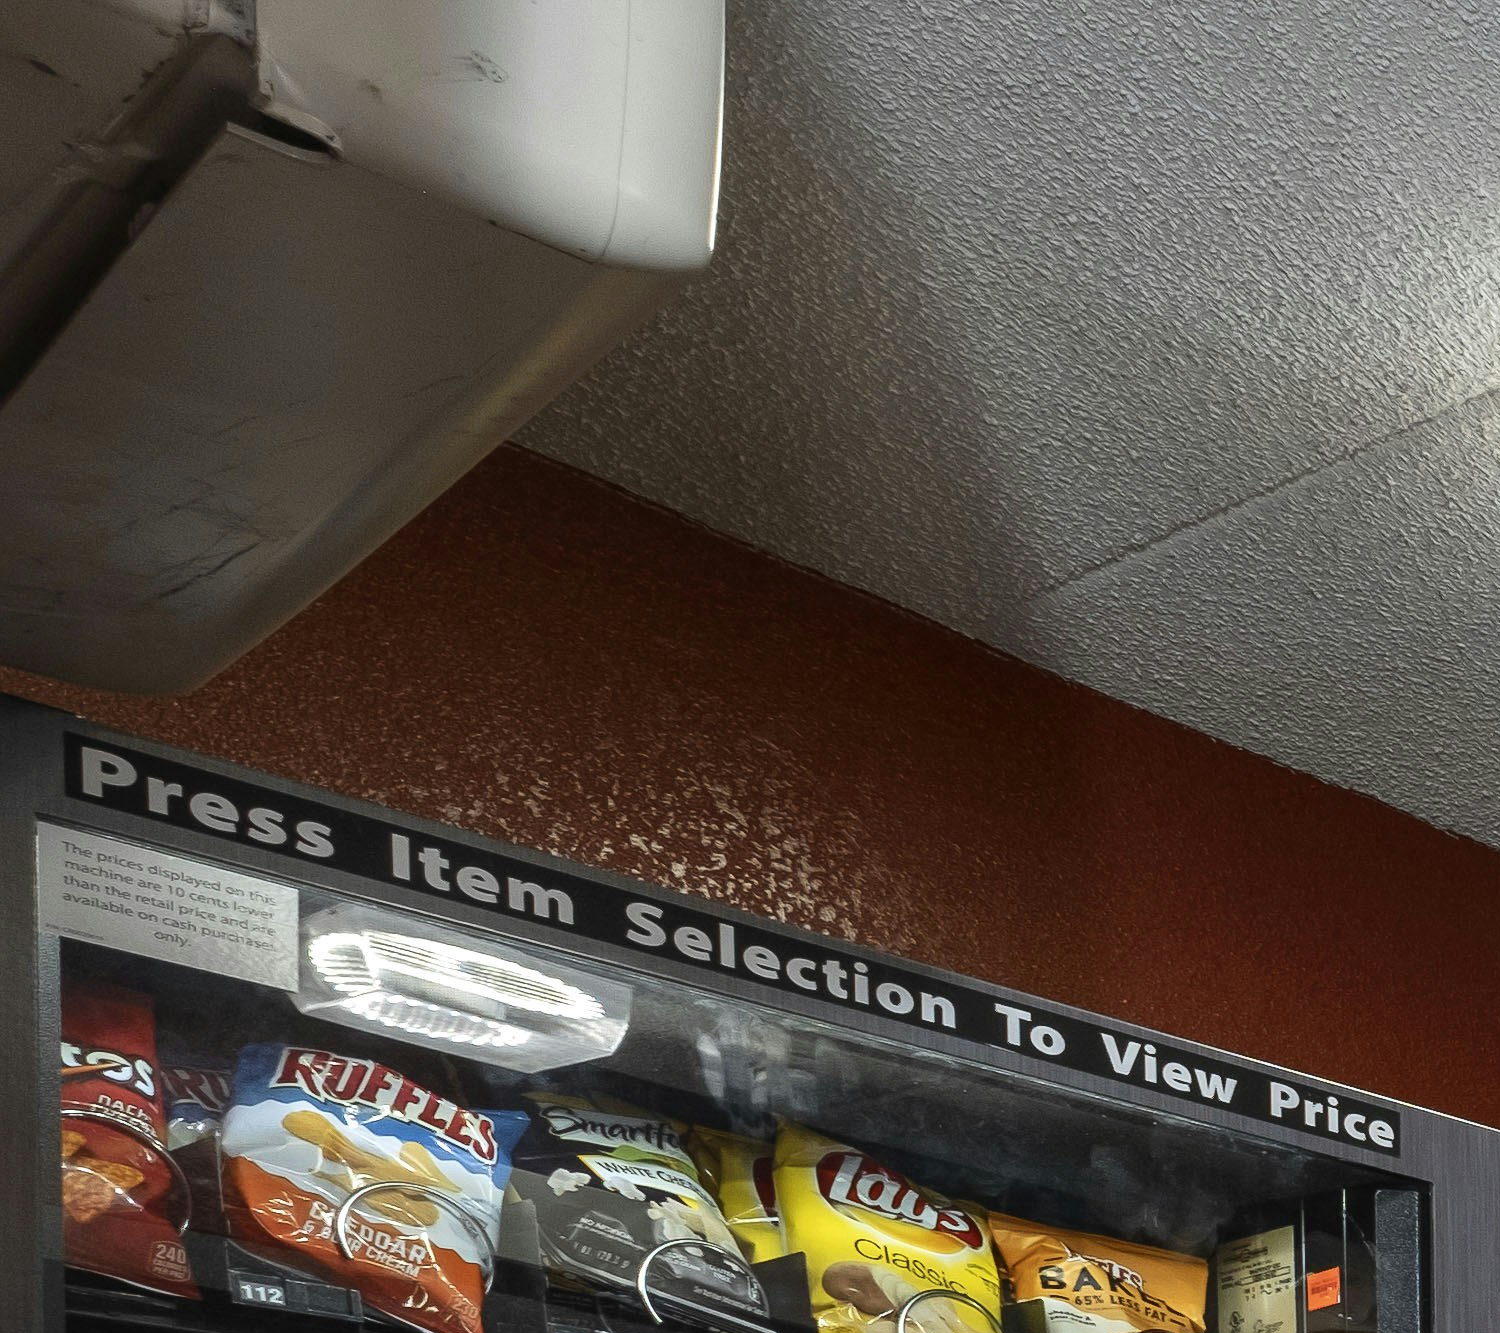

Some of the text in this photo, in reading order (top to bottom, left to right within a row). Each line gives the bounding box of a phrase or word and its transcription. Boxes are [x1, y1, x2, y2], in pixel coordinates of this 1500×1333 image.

[62, 840, 245, 898] The prices displayed on
[65, 860, 230, 910] machine are 10 cents
[62, 892, 197, 932] available on cash
[63, 874, 249, 930] than the retail price and
[80, 746, 1396, 1150] Press Item Selection To View Price
[153, 929, 192, 949] only.
[274, 1047, 498, 1164] RUFFLES
[597, 1159, 656, 1183] WHITE
[853, 1238, 969, 1297] Classic
[240, 1283, 285, 1306] 112
[1073, 1294, 1168, 1323] 65% LESS FAT
